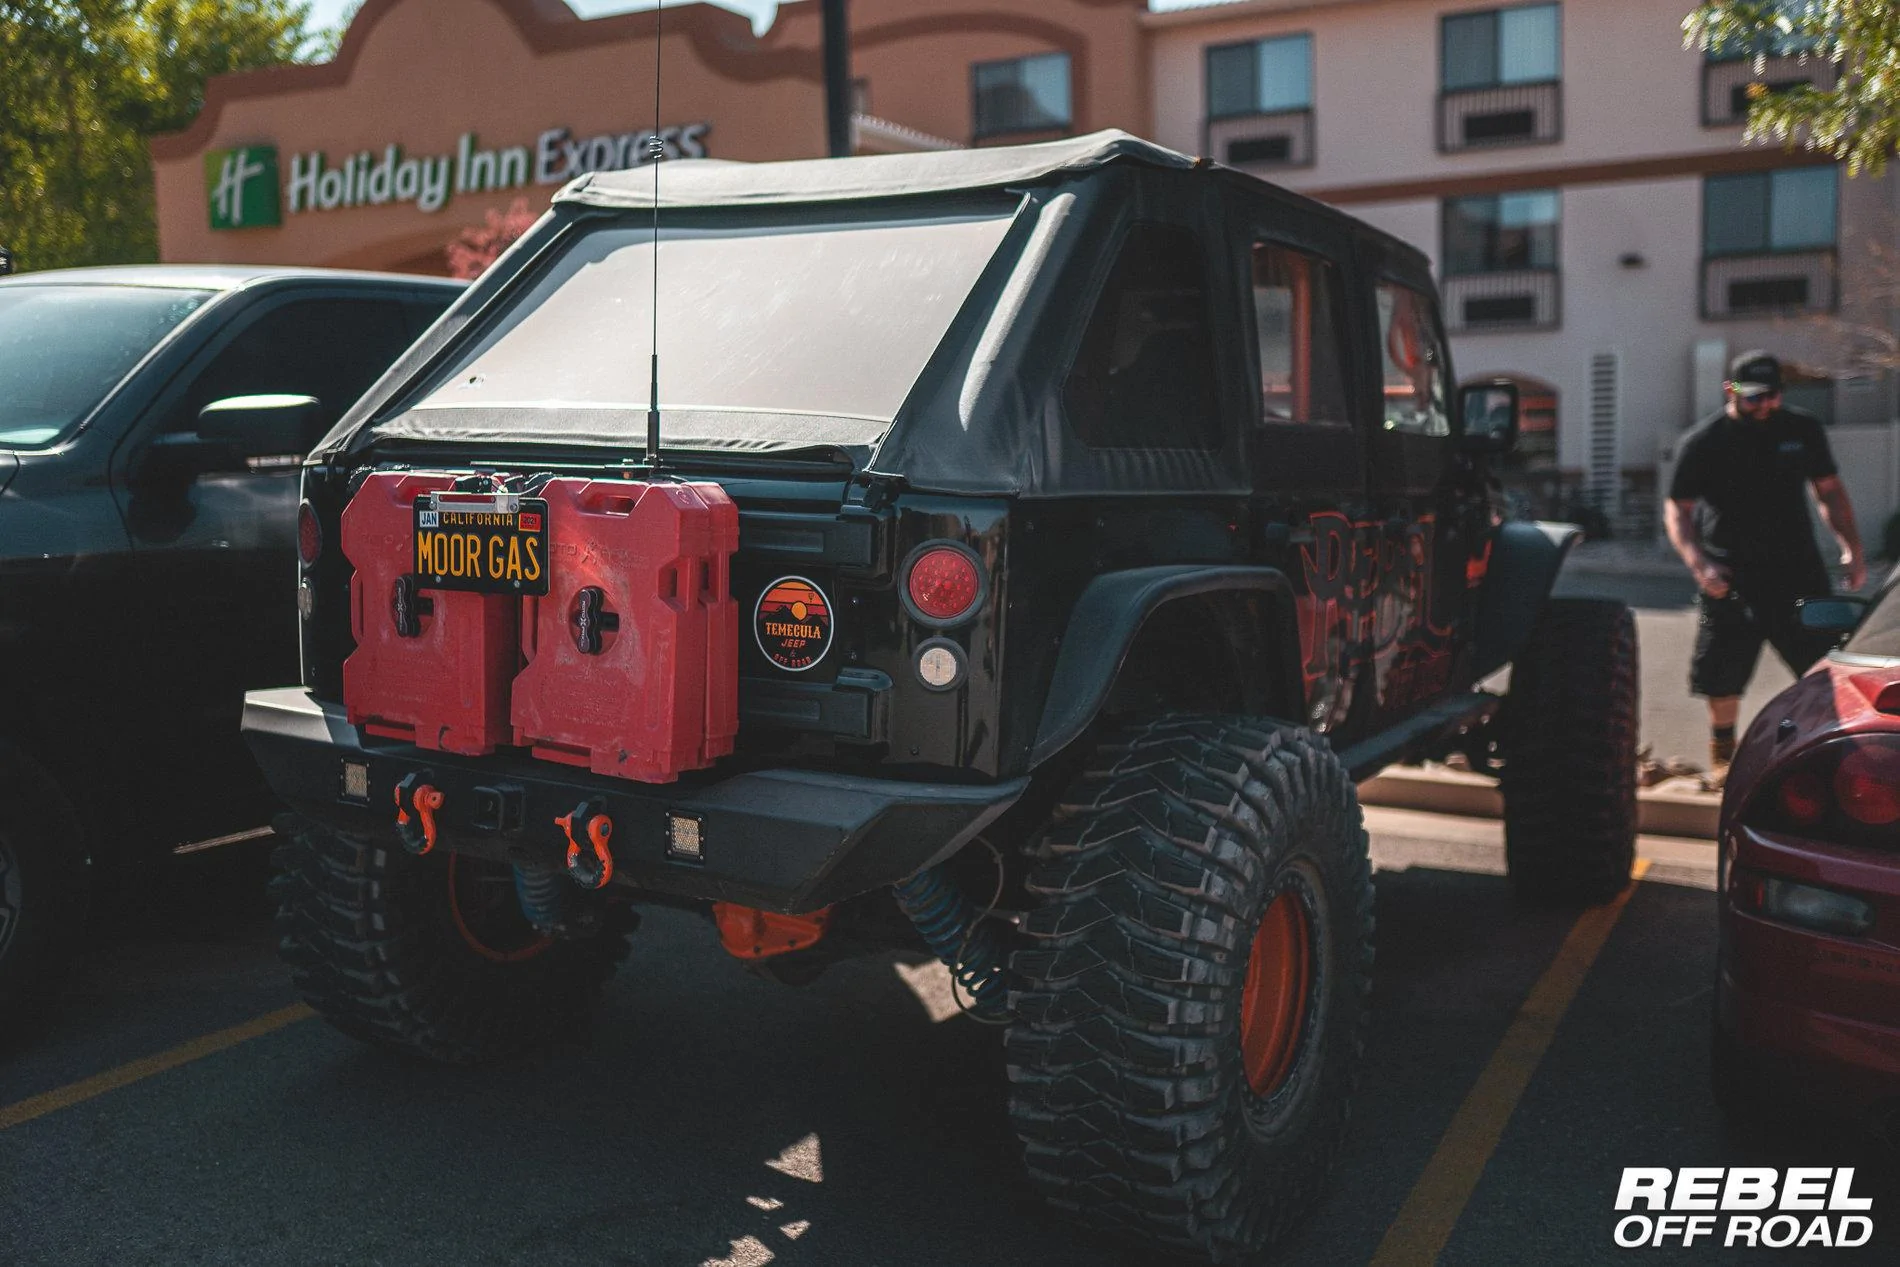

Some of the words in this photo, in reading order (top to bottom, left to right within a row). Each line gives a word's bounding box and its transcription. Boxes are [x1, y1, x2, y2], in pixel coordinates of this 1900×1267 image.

[288, 144, 450, 213] Holiday
[456, 133, 528, 193] Inn
[535, 122, 711, 184] Express
[421, 512, 438, 526] JAN
[443, 511, 514, 526] CALIFORNIA
[417, 531, 481, 578] MOOR
[488, 535, 541, 580] GAS
[765, 622, 821, 639] TEMECULA
[781, 638, 806, 648] JEEP
